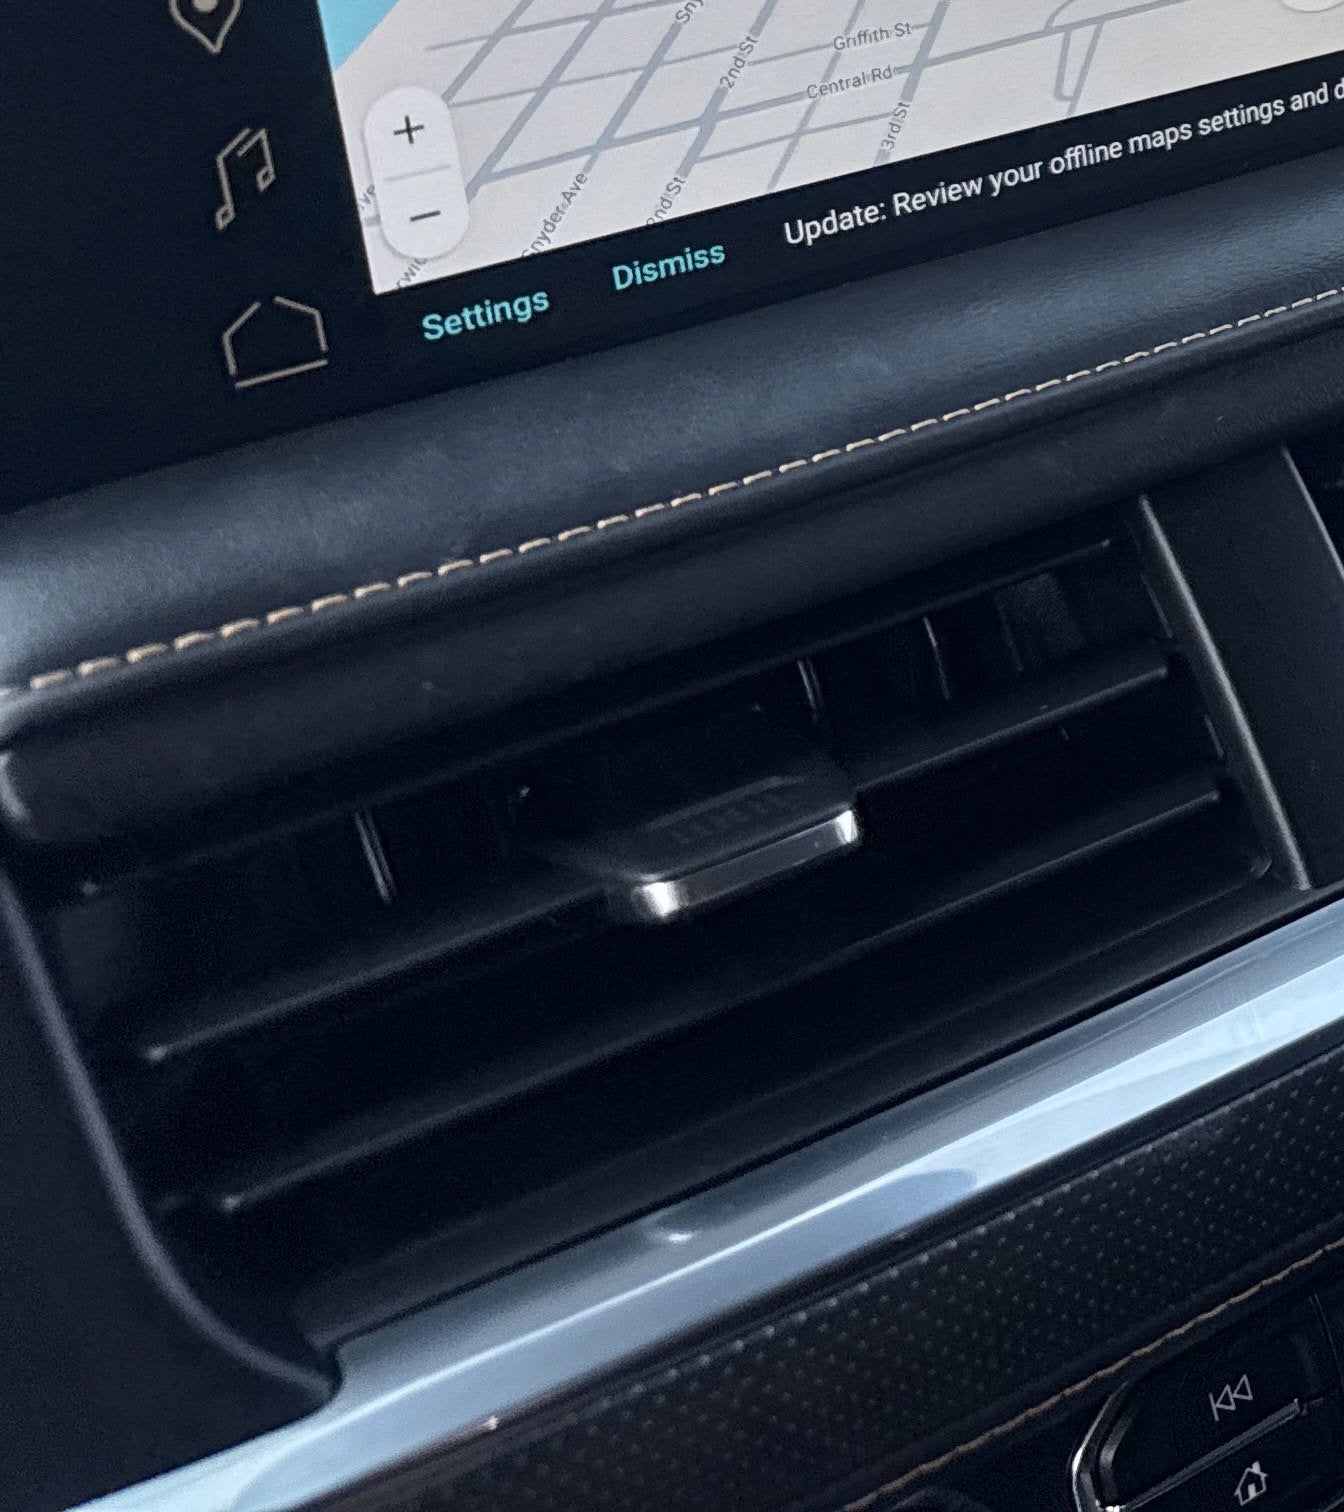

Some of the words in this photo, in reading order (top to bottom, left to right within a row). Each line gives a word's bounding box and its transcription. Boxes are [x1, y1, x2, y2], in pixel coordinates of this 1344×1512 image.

[833, 28, 890, 51] Griffith
[894, 22, 912, 37] St
[719, 55, 746, 89] 2nd
[739, 36, 757, 55] St
[806, 72, 867, 99] Central
[871, 65, 894, 83] Rd
[881, 122, 901, 151] 3rd
[895, 101, 911, 120] St
[665, 176, 686, 196] St
[784, 201, 888, 247] Update:
[892, 176, 983, 217] Review
[989, 160, 1043, 196] your
[1050, 138, 1123, 176] offline
[1128, 122, 1192, 156] maps
[1198, 98, 1285, 137] settings
[1290, 82, 1330, 112] and
[561, 172, 588, 208] Ave
[611, 244, 726, 291] Dismiss
[421, 291, 550, 341] Settings
